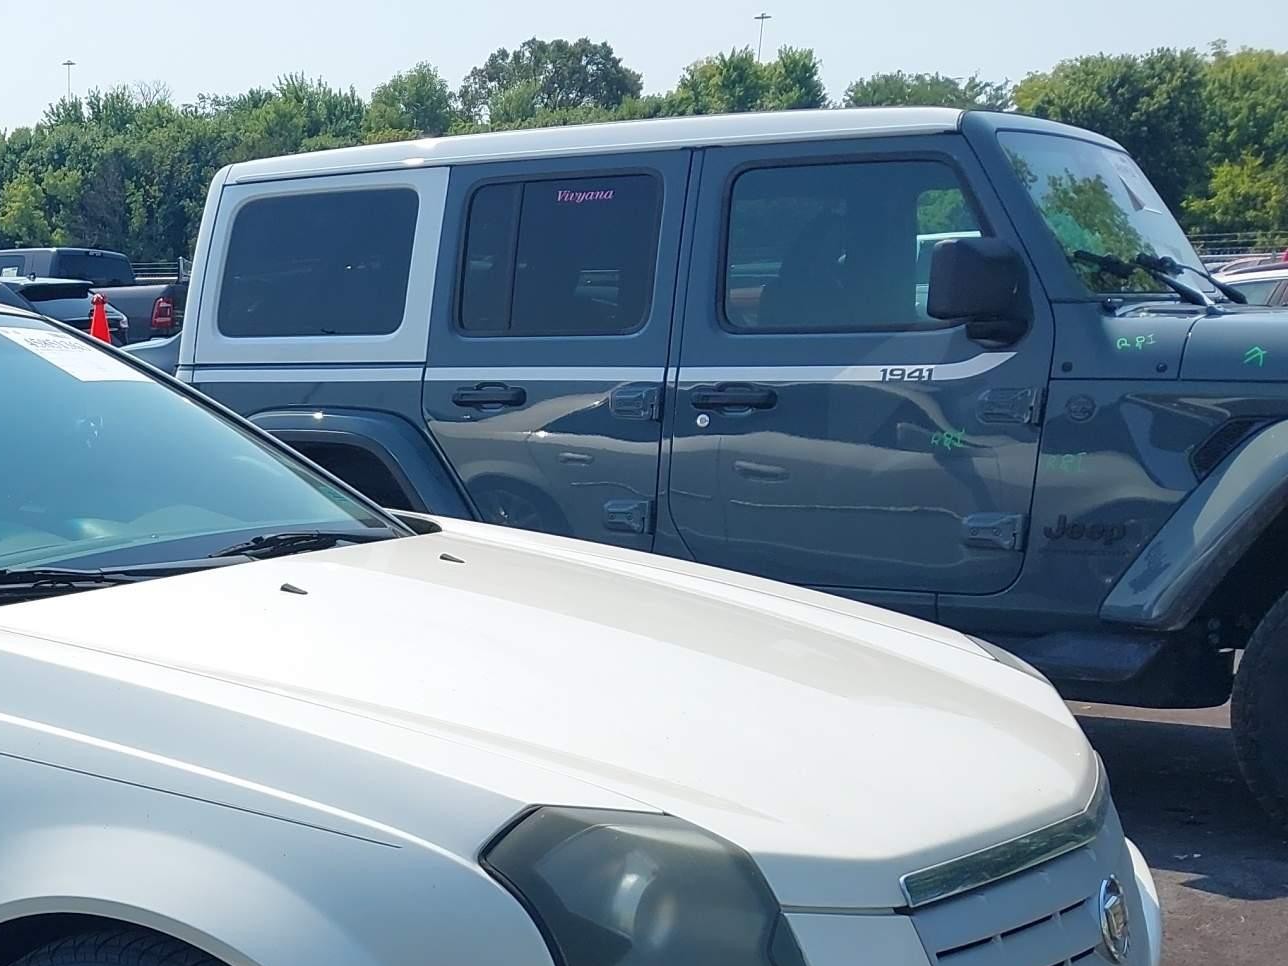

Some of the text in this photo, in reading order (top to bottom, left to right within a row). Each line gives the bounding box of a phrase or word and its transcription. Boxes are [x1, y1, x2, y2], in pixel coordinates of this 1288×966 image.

[557, 190, 614, 203] Vivyana
[879, 367, 934, 384] 1941
[1043, 513, 1127, 545] Jeep
